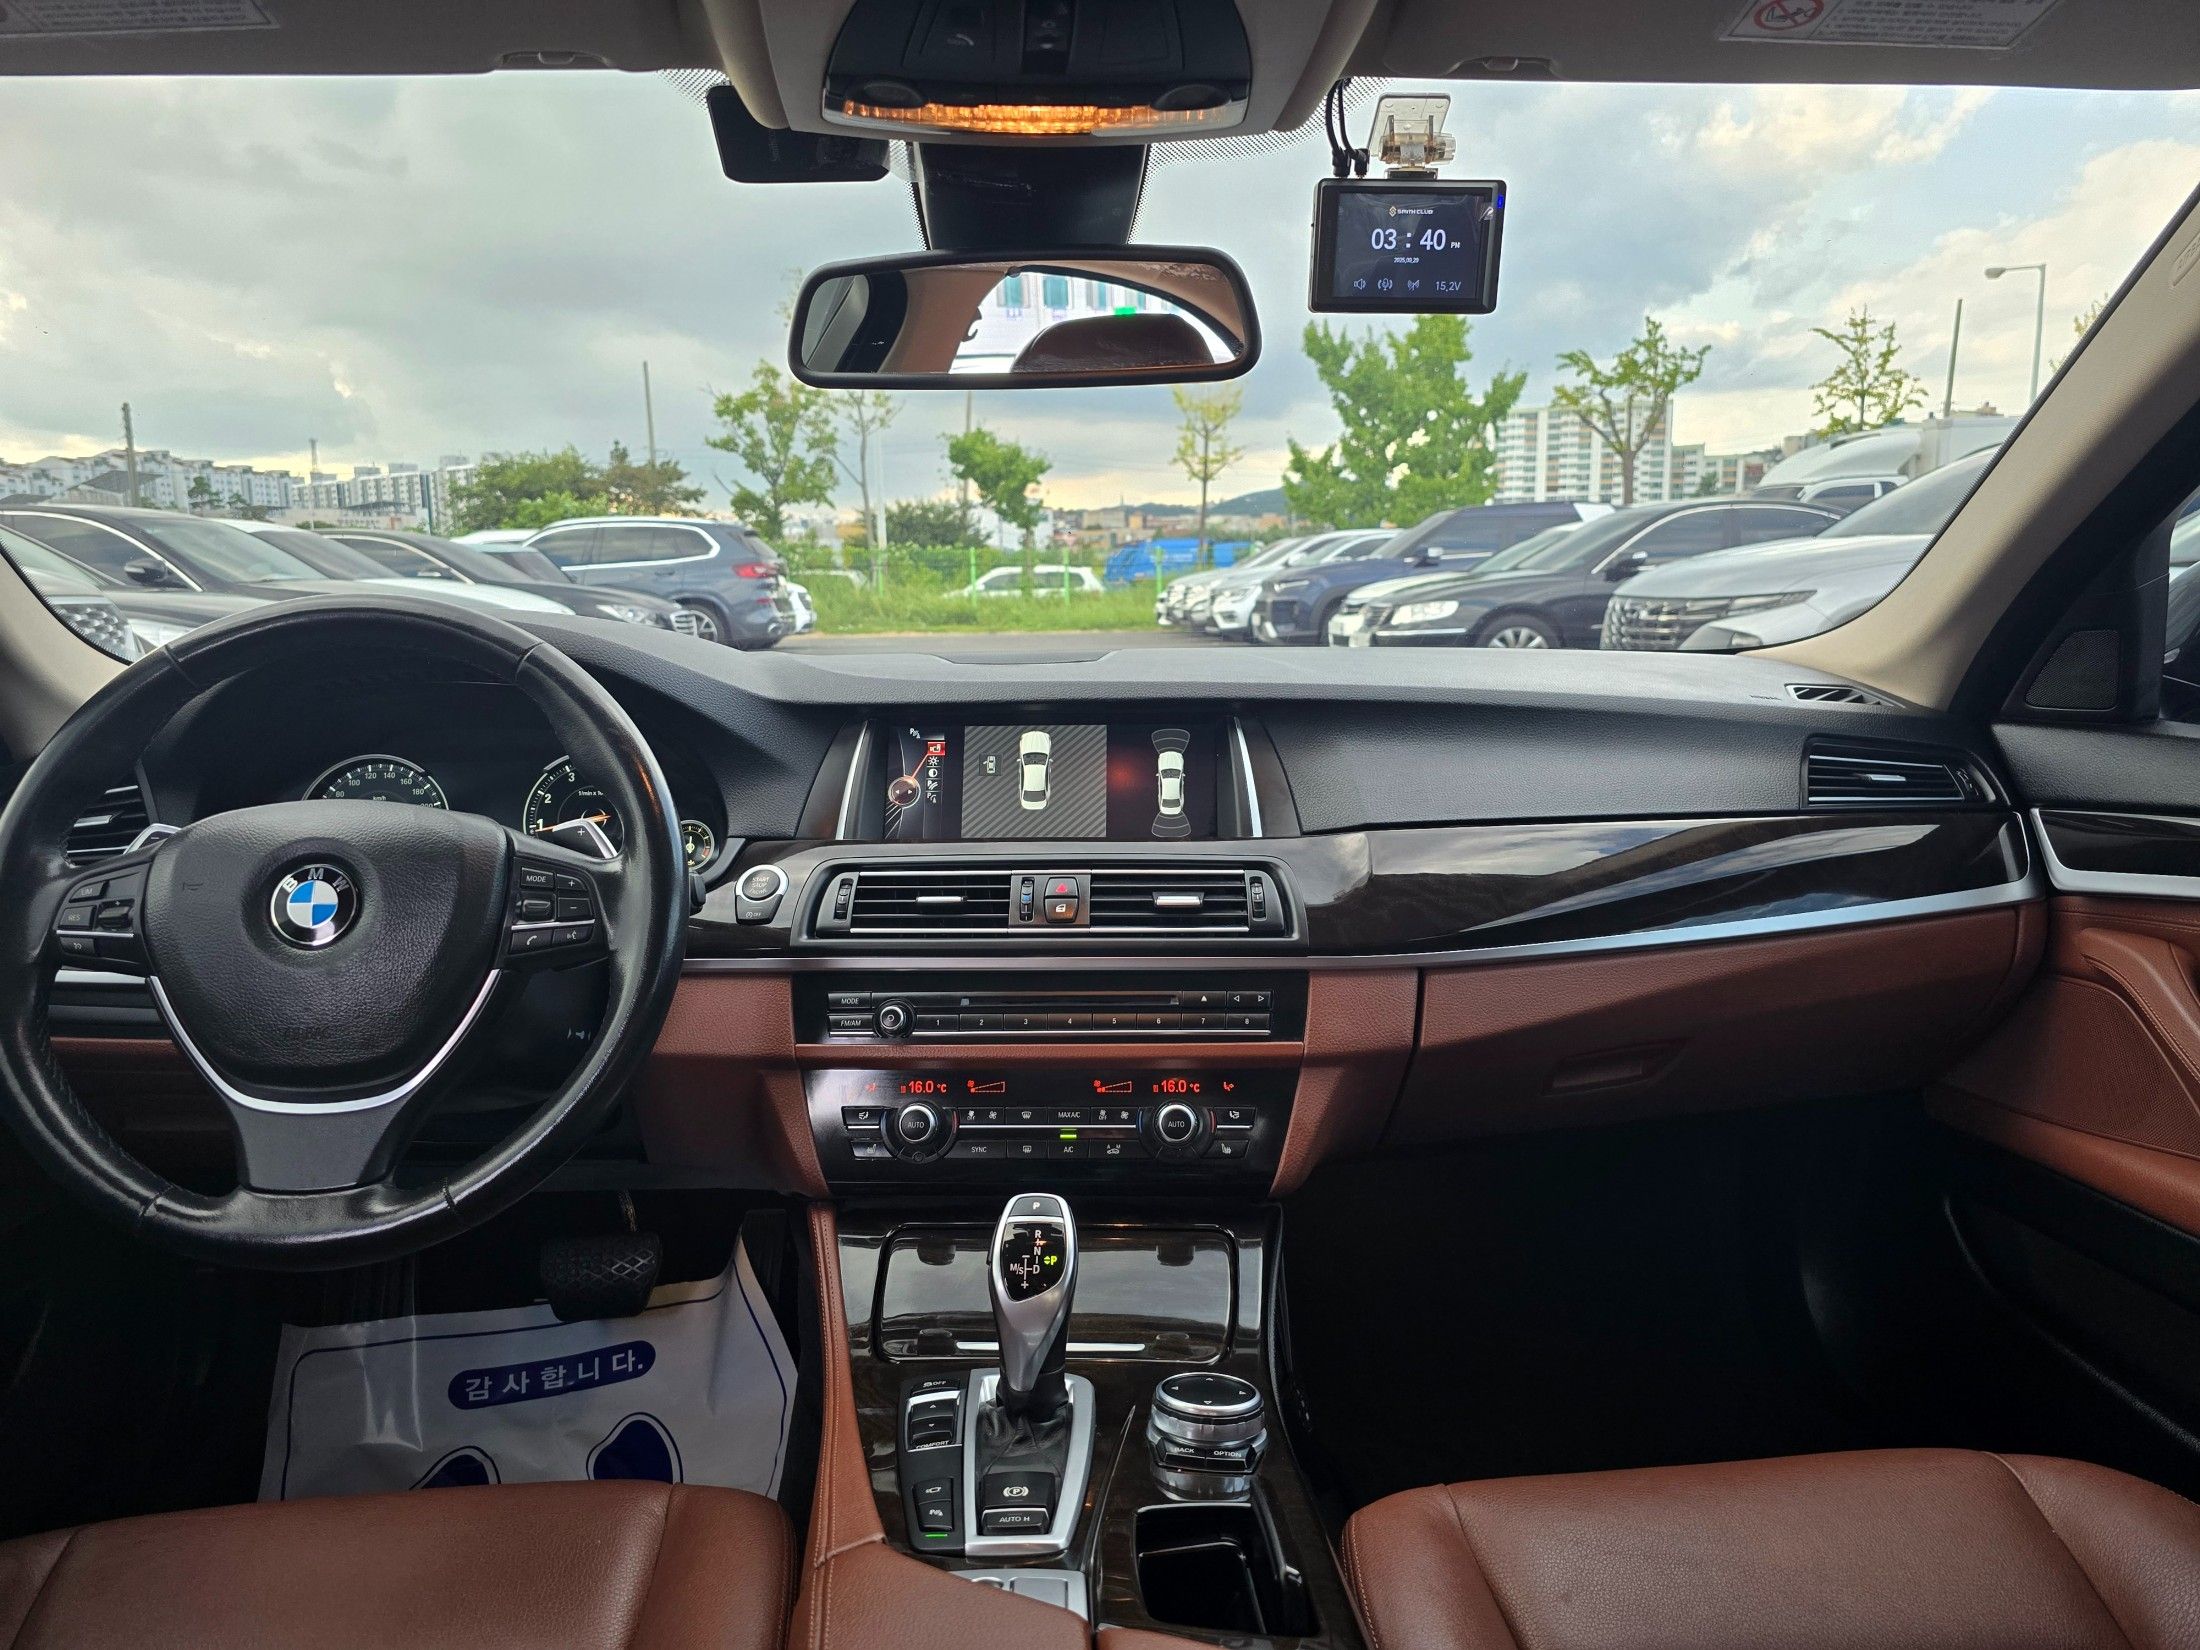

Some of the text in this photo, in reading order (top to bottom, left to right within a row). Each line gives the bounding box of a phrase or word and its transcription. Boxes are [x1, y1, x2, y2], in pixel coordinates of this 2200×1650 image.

[1371, 228, 1397, 250] 03
[1419, 228, 1446, 250] 40
[1450, 241, 1460, 249] PM
[1435, 281, 1461, 292] 15.2V
[568, 773, 575, 782] 3
[545, 794, 552, 804] 2
[537, 818, 544, 831] 1
[282, 867, 350, 893] BMW
[526, 875, 546, 883] MODE
[841, 997, 859, 1005] MODE
[840, 1019, 861, 1027] FM/AM
[908, 1080, 934, 1093] 16.0
[1161, 1079, 1187, 1093] 16.0
[1168, 1120, 1185, 1128] AUTO
[971, 1146, 987, 1154] SYNC
[1063, 1145, 1074, 1153] A/C
[1032, 1202, 1040, 1210] P
[1034, 1230, 1041, 1238] R
[1034, 1247, 1041, 1255] N
[1050, 1256, 1057, 1265] P
[1032, 1265, 1040, 1274] D
[464, 1349, 643, 1401] 감사합니다.
[916, 1440, 949, 1449] COMFORT
[1213, 1450, 1242, 1458] OPTION
[999, 1515, 1021, 1523] AUTO
